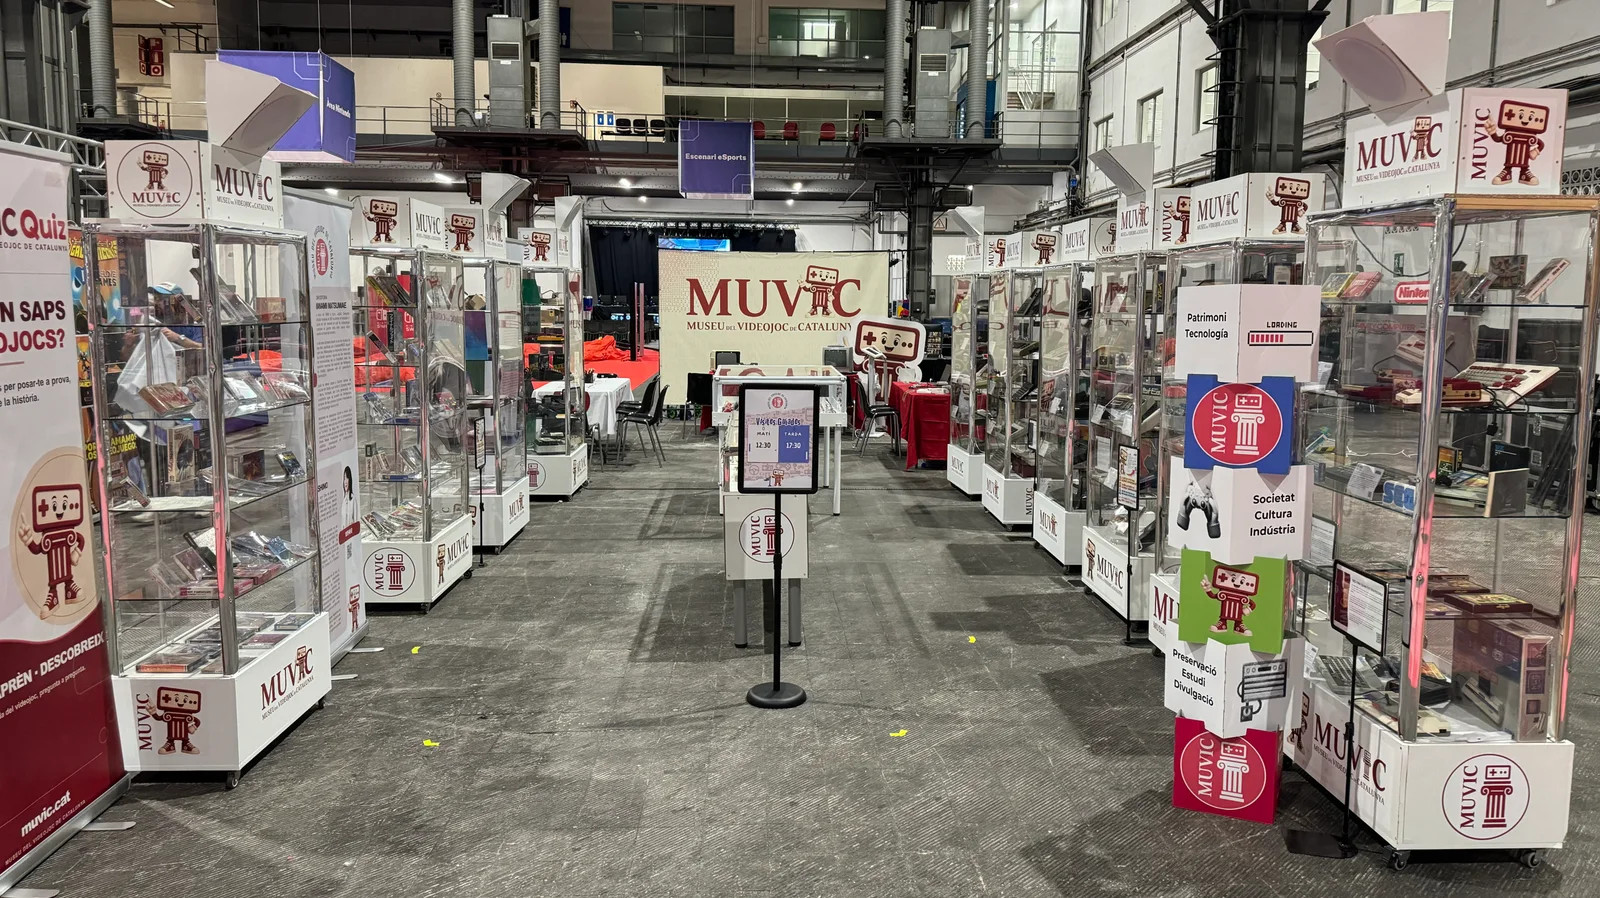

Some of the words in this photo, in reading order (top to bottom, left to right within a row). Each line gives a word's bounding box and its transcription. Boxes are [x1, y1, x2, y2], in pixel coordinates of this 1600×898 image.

[717, 153, 747, 161] eSports
[1471, 108, 1490, 180] MUVIC
[214, 164, 273, 203] MUVIC
[1356, 173, 1374, 183] MUSEU
[1378, 167, 1404, 179] VIDEOJOC
[1407, 161, 1441, 174] CATALUNYA
[132, 192, 181, 203] MUVIC
[1197, 191, 1239, 222] MUVIC
[20, 209, 66, 240] Quiz
[415, 212, 441, 235] MUVIC
[1162, 201, 1172, 242] MUVIC
[1065, 229, 1086, 248] MUVIC
[686, 273, 862, 317] MUVIC
[20, 300, 66, 322] SAPS
[1187, 312, 1227, 323] Patrimoni
[687, 321, 725, 331] MUSEU
[737, 322, 789, 334] VIDEOJOC
[1185, 328, 1229, 341] Tecnología
[3, 383, 16, 393] per
[17, 379, 44, 392] posar-te
[51, 376, 71, 387] prova,
[4, 397, 11, 406] la
[12, 394, 40, 405] història.
[1210, 392, 1229, 454] MUVIC
[1025, 487, 1033, 516] MUVIC
[1253, 492, 1295, 504] Societat
[1254, 509, 1293, 520] Cultura
[750, 515, 761, 556] MUVIC
[1250, 524, 1296, 537] Indústria
[447, 532, 470, 564] MUVIC
[374, 554, 384, 590] MUVIC
[1096, 552, 1123, 590] MUVIC
[40, 631, 105, 677] DESCOBREIX
[1172, 648, 1217, 676] Preservació
[1182, 668, 1206, 687] Estudi
[5, 705, 14, 716] del
[15, 693, 39, 711] videojoc,
[39, 679, 60, 698] pregunta
[1174, 679, 1214, 706] Divulgació
[135, 693, 153, 751] MUVIC
[1198, 738, 1215, 797] MUVIC
[1460, 765, 1478, 829] MUVIC
[21, 790, 71, 837] muvic.cat
